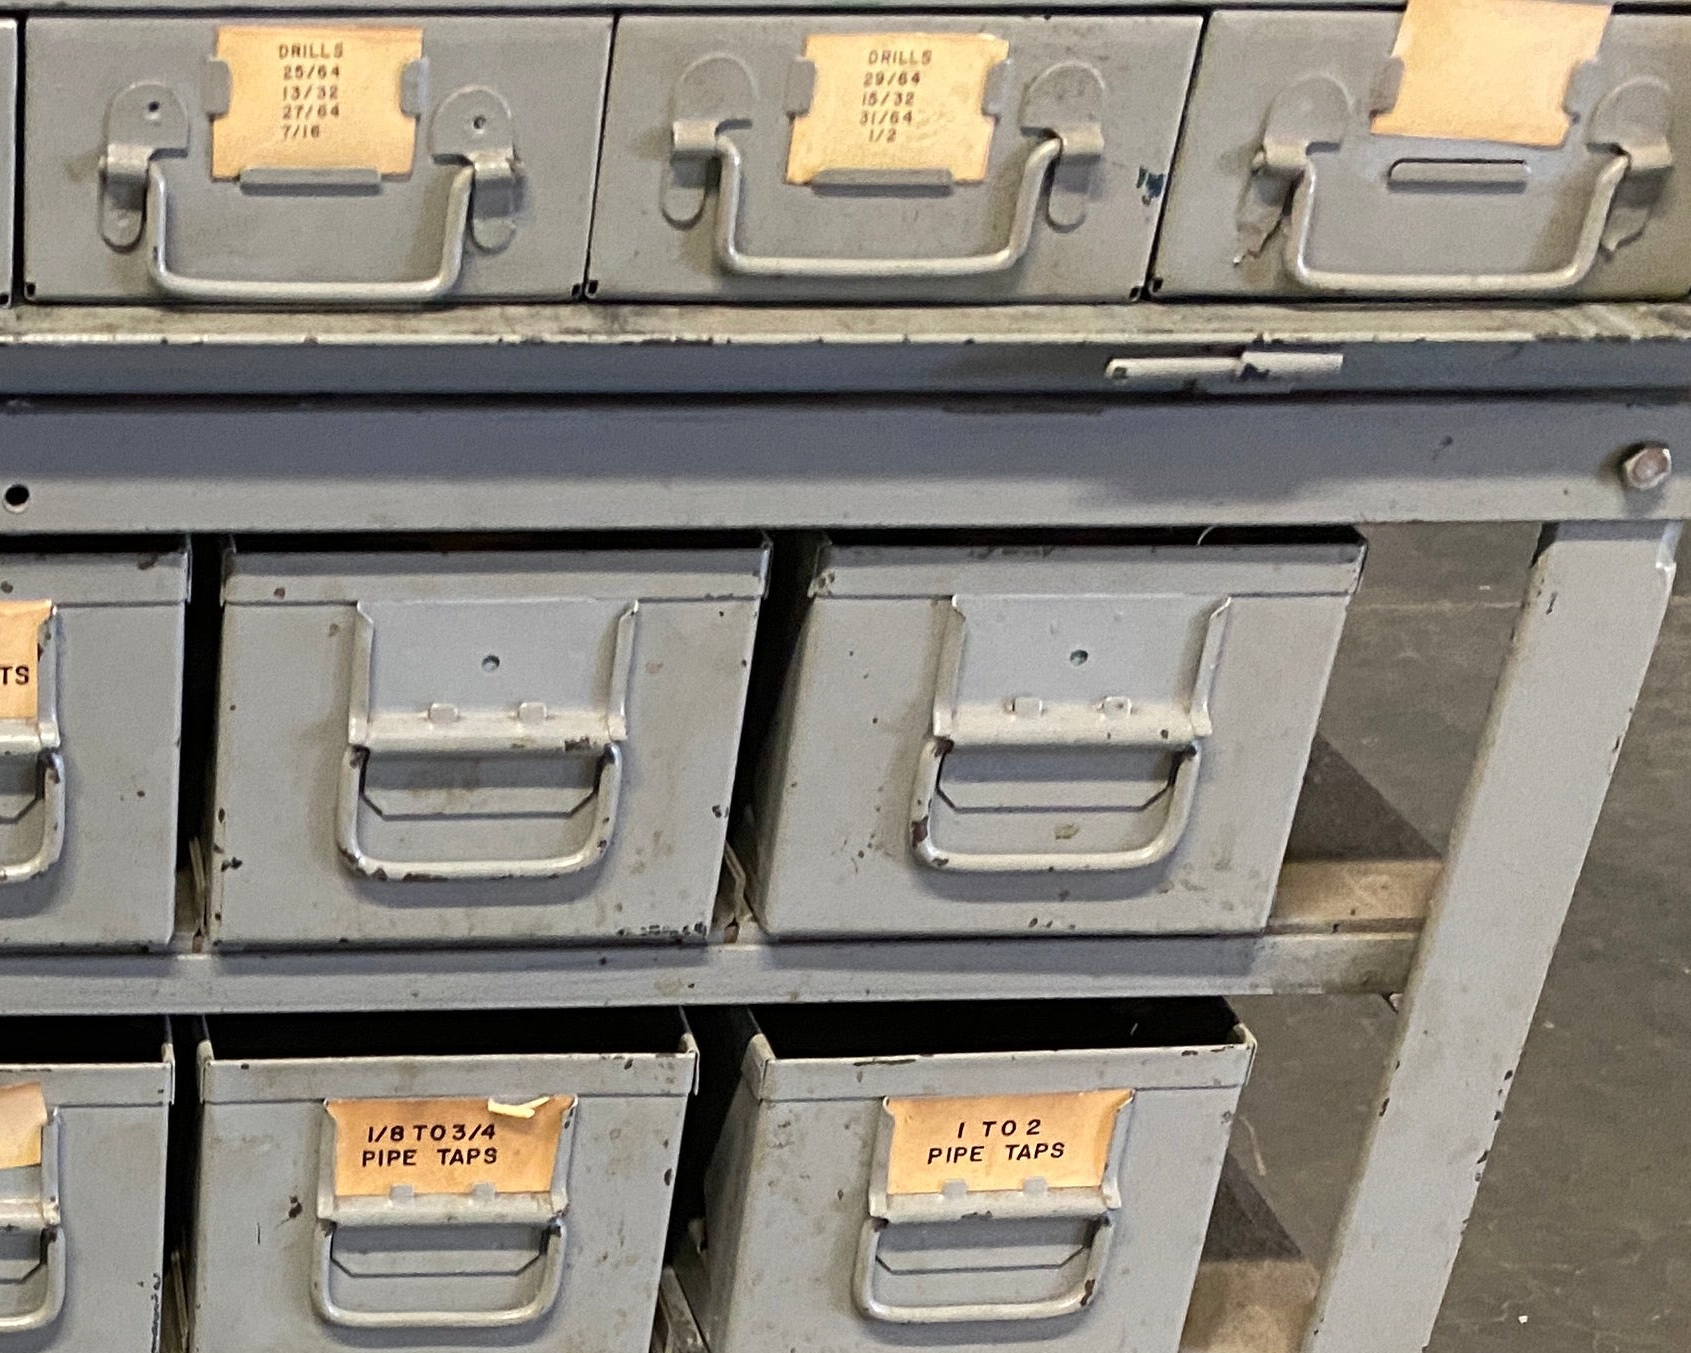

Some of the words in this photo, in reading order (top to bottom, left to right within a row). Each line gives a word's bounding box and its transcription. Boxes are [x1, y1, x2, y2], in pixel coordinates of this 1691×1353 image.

[279, 42, 343, 59] DRILLS
[869, 49, 932, 65] DRILLS
[284, 65, 340, 80] 25/64
[863, 72, 921, 87] 29/64
[283, 85, 338, 101] 13/32
[862, 92, 914, 106] 15/32
[282, 104, 340, 120] 27/64
[859, 111, 913, 126] 31/64
[282, 125, 320, 139] 7/16
[869, 128, 897, 143] 1/2
[368, 1125, 404, 1143] 1/8
[413, 1124, 446, 1142] TO
[452, 1124, 496, 1141] 3/4
[982, 1120, 1016, 1137] TO
[1027, 1119, 1041, 1135] 2
[362, 1149, 418, 1167] PIPE
[437, 1147, 497, 1166] TAPS
[927, 1145, 984, 1164] PIPE
[1005, 1142, 1065, 1161] TAPS
